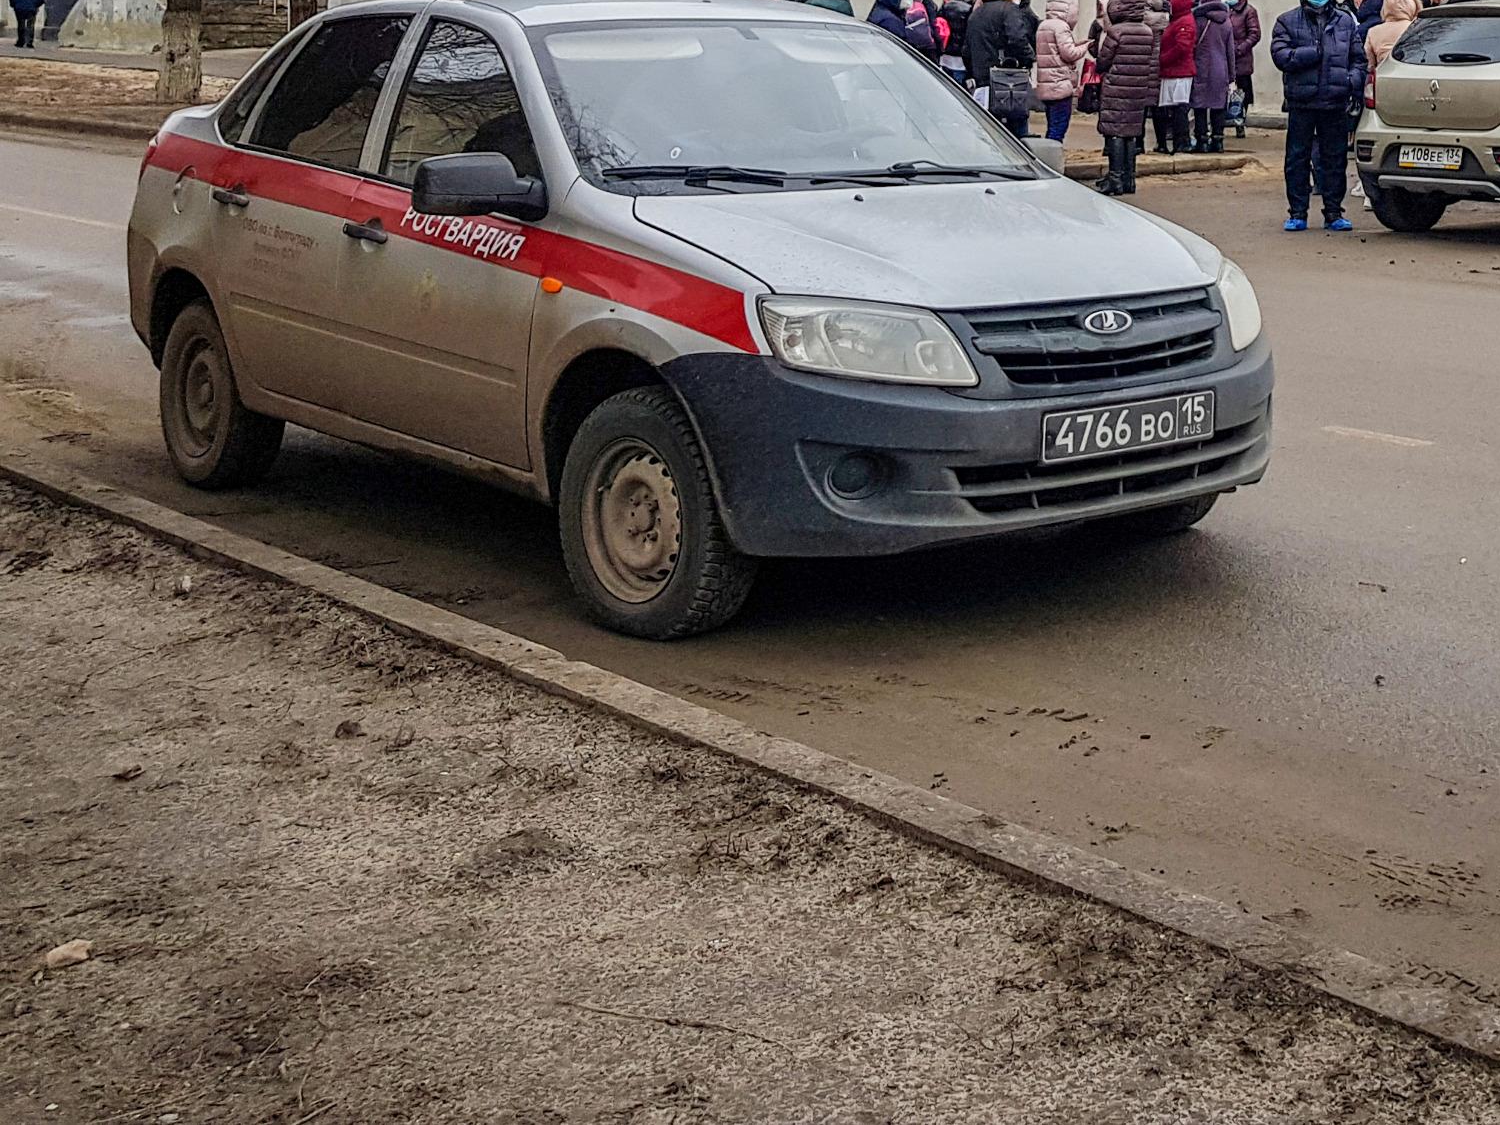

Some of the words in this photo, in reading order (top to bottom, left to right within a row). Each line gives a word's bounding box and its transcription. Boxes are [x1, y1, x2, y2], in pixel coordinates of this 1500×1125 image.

[400, 205, 526, 261] РОСГВАРДИЯ
[1055, 409, 1132, 454] 4766
[1140, 411, 1174, 443] ВО
[1181, 396, 1205, 424] 15
[1183, 425, 1202, 436] RUS
